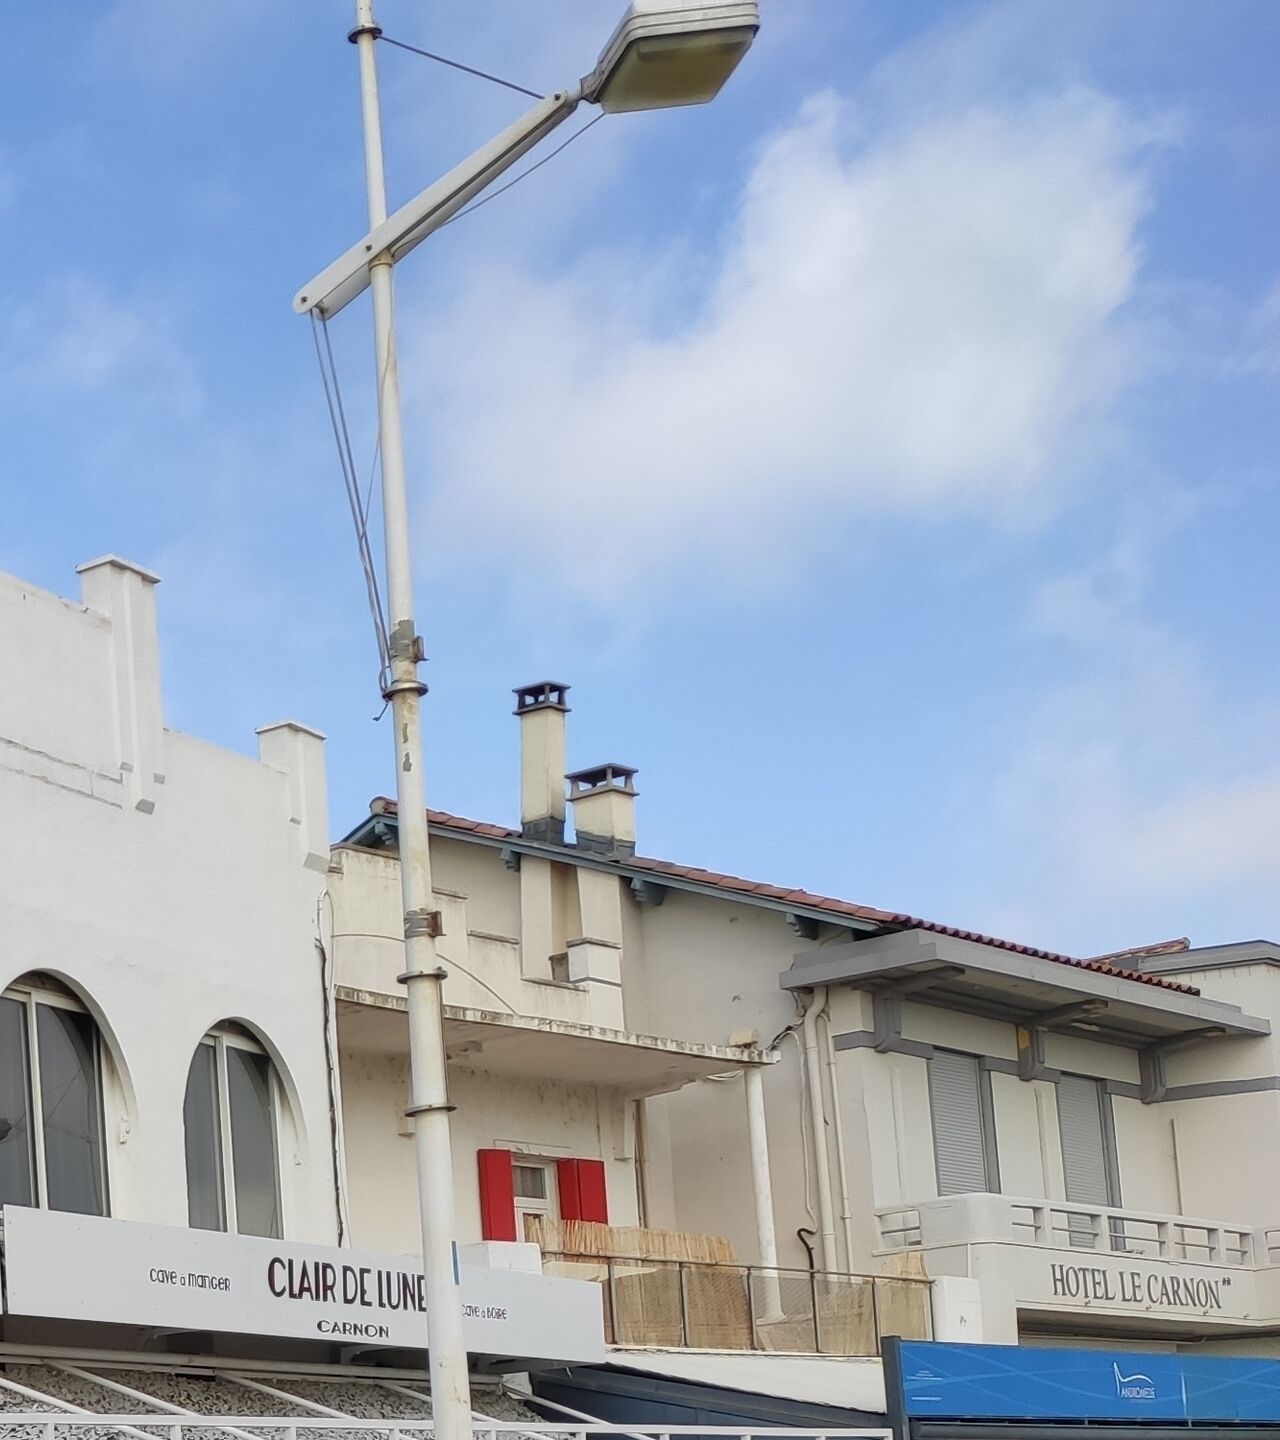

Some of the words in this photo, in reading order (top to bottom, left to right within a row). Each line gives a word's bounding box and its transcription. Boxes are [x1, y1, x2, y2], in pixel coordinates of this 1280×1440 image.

[267, 1256, 337, 1304] CLAIR
[342, 1264, 373, 1307] DE
[377, 1269, 427, 1313] LUNE
[1051, 1263, 1116, 1301] HOTEL
[1118, 1270, 1144, 1303] LE
[1146, 1273, 1222, 1310] CARNON
[316, 1319, 389, 1339] CARNON
